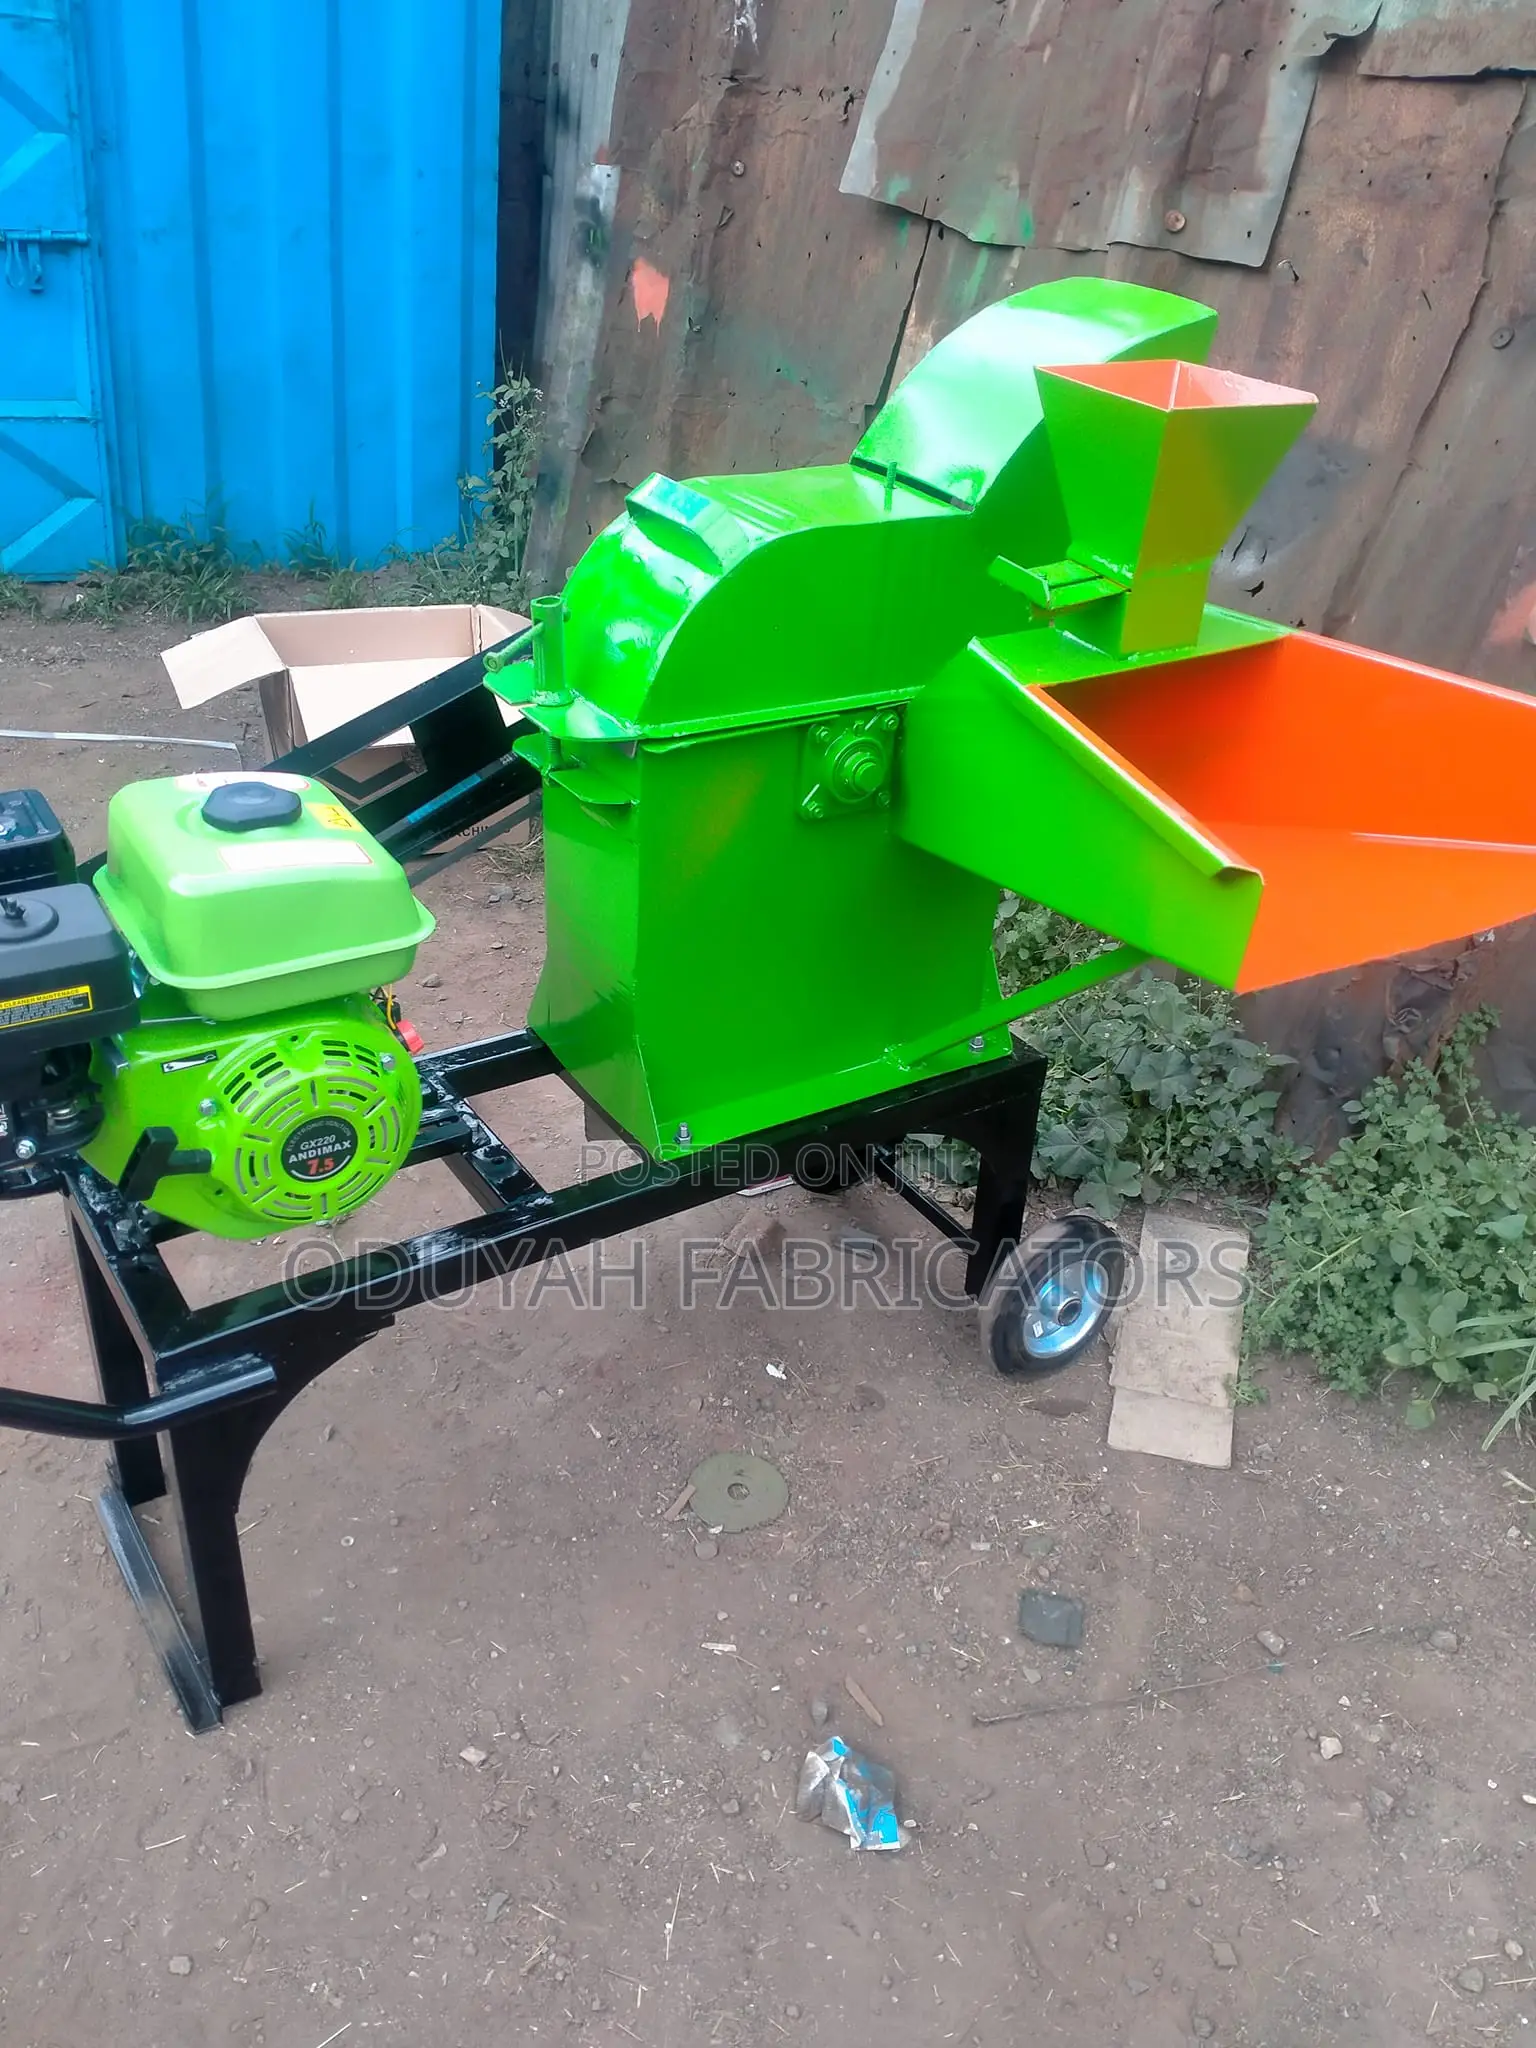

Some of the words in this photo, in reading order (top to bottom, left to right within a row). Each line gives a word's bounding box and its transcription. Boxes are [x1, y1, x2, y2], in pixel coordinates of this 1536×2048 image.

[288, 1140, 352, 1164] ANDIMAX
[300, 1134, 336, 1151] GX220
[306, 1157, 335, 1176] 7.5
